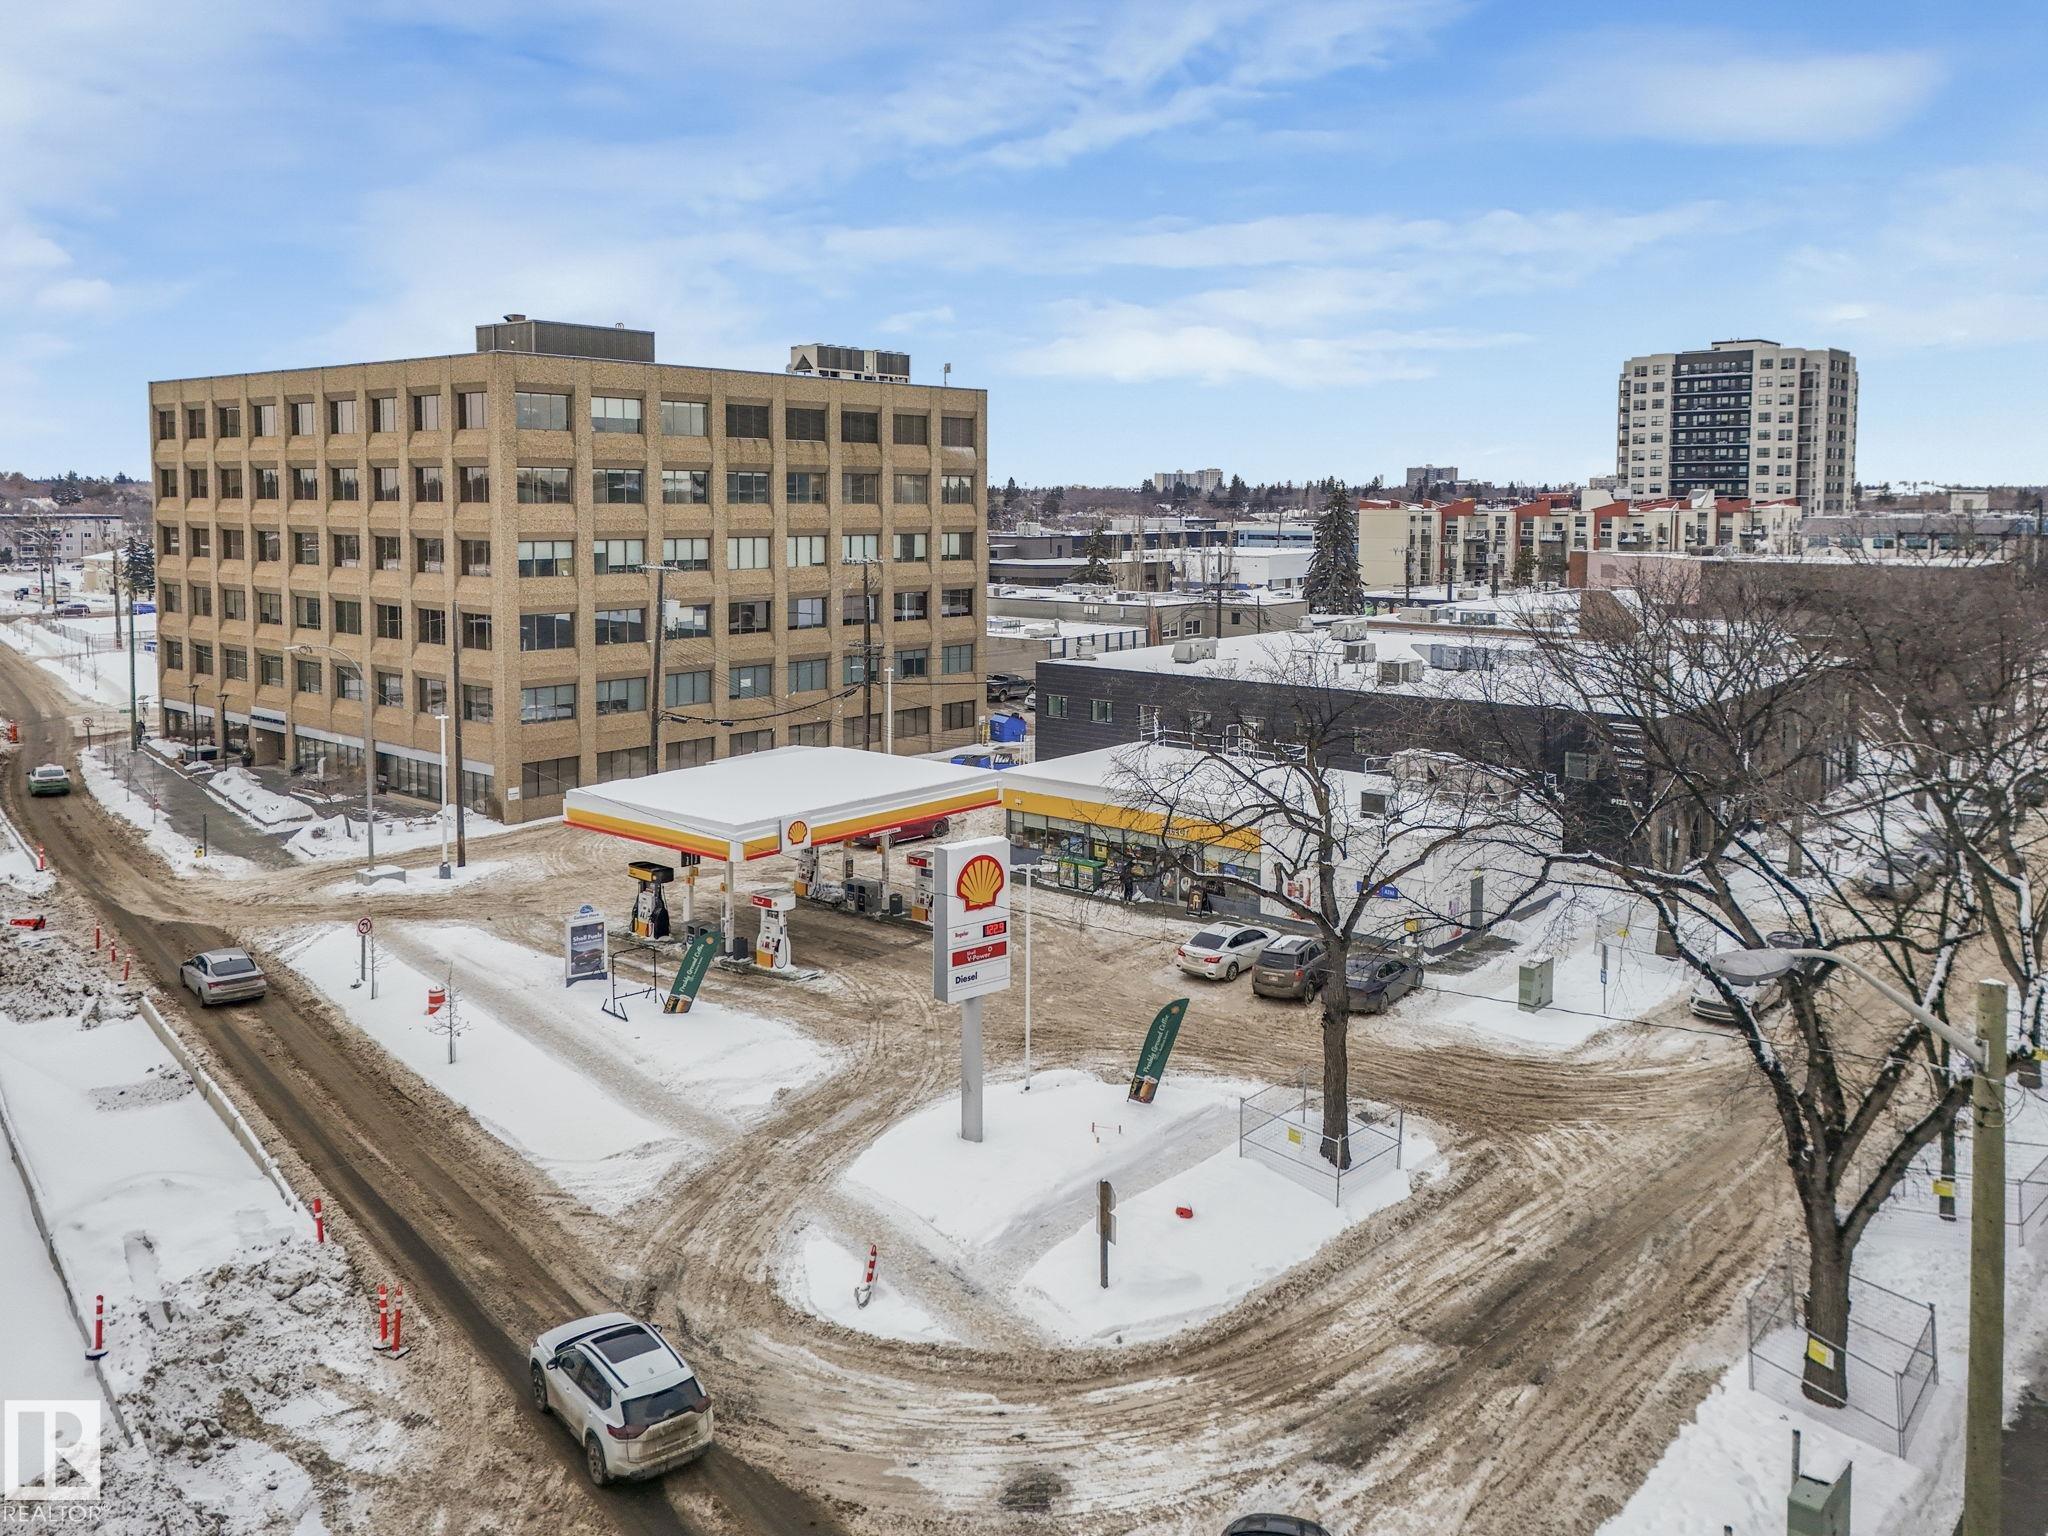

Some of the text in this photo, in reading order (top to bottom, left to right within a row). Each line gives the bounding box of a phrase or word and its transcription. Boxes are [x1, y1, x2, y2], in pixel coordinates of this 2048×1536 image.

[588, 932, 602, 940] Fuels
[966, 952, 991, 962] V-Power
[955, 971, 977, 984] Diesel
